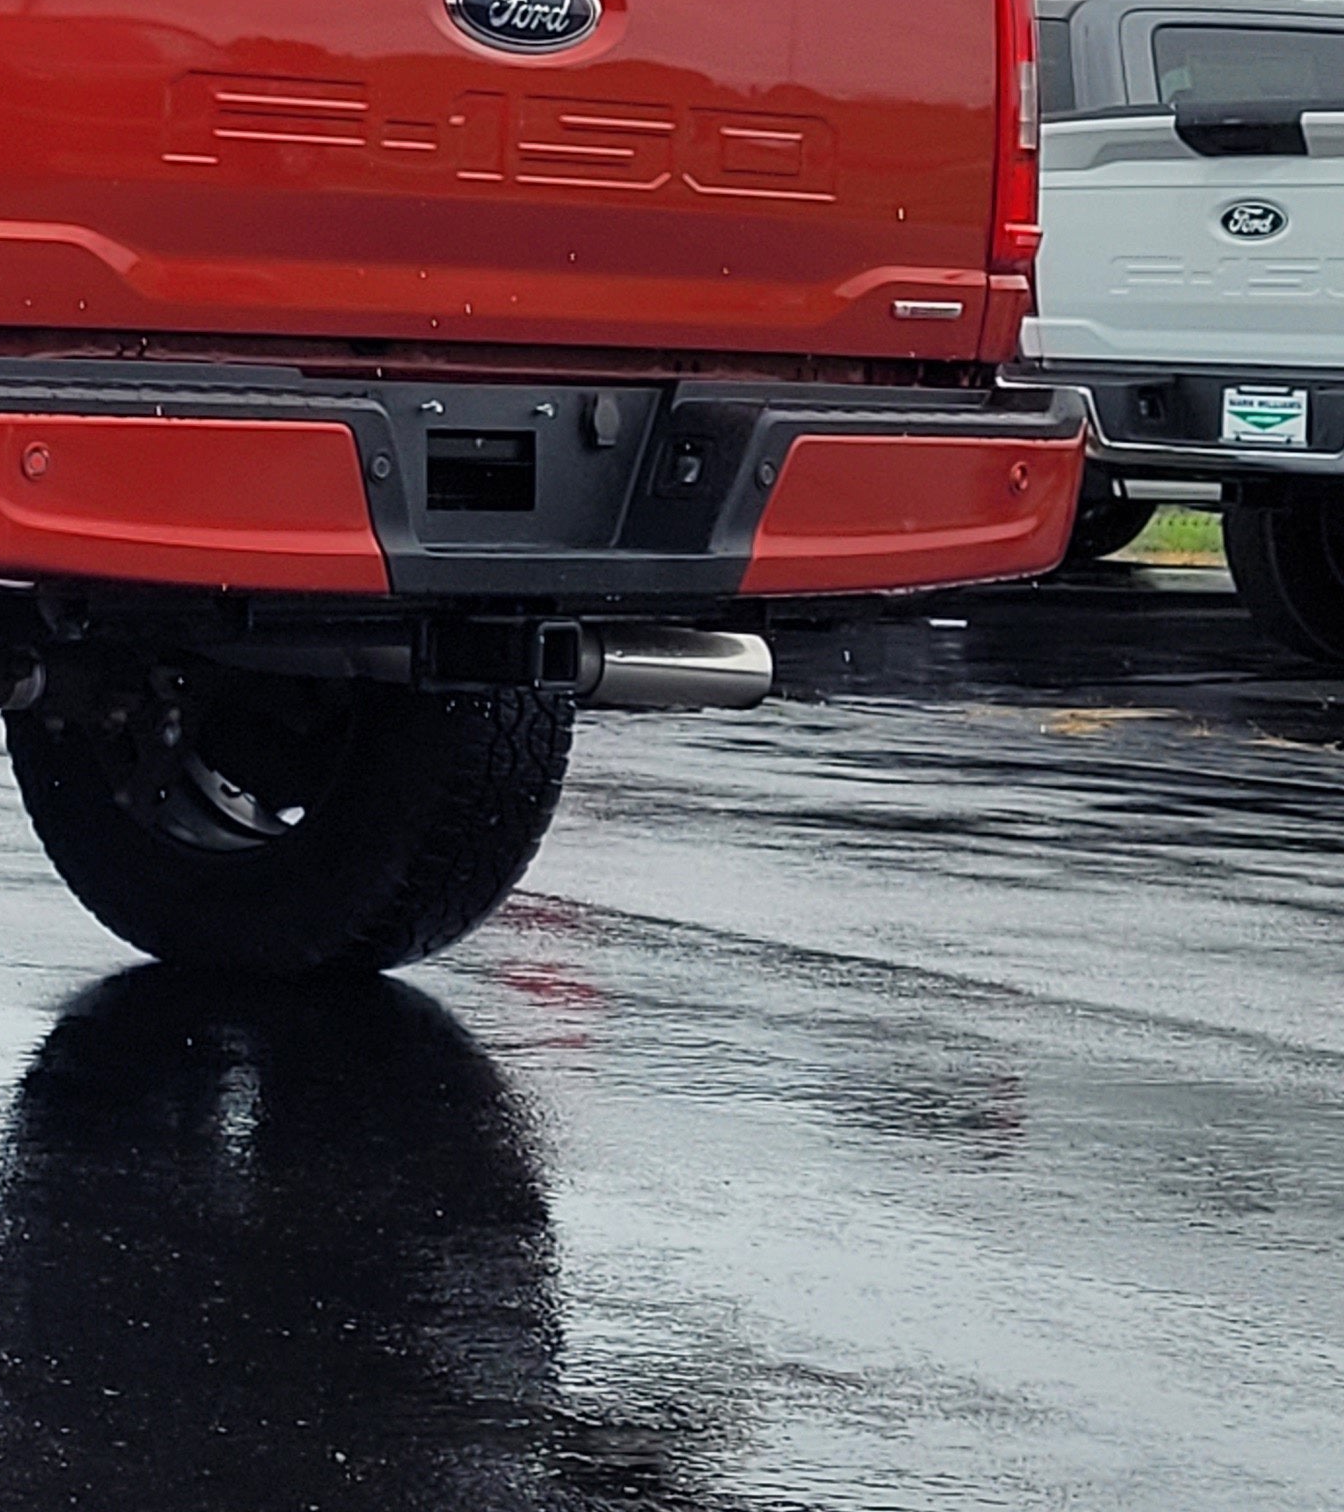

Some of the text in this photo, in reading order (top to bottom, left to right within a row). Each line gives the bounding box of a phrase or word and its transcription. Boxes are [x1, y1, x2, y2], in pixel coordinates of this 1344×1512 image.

[160, 67, 838, 201] F-150
[1229, 206, 1275, 233] Ford
[1110, 255, 1344, 296] F-15
